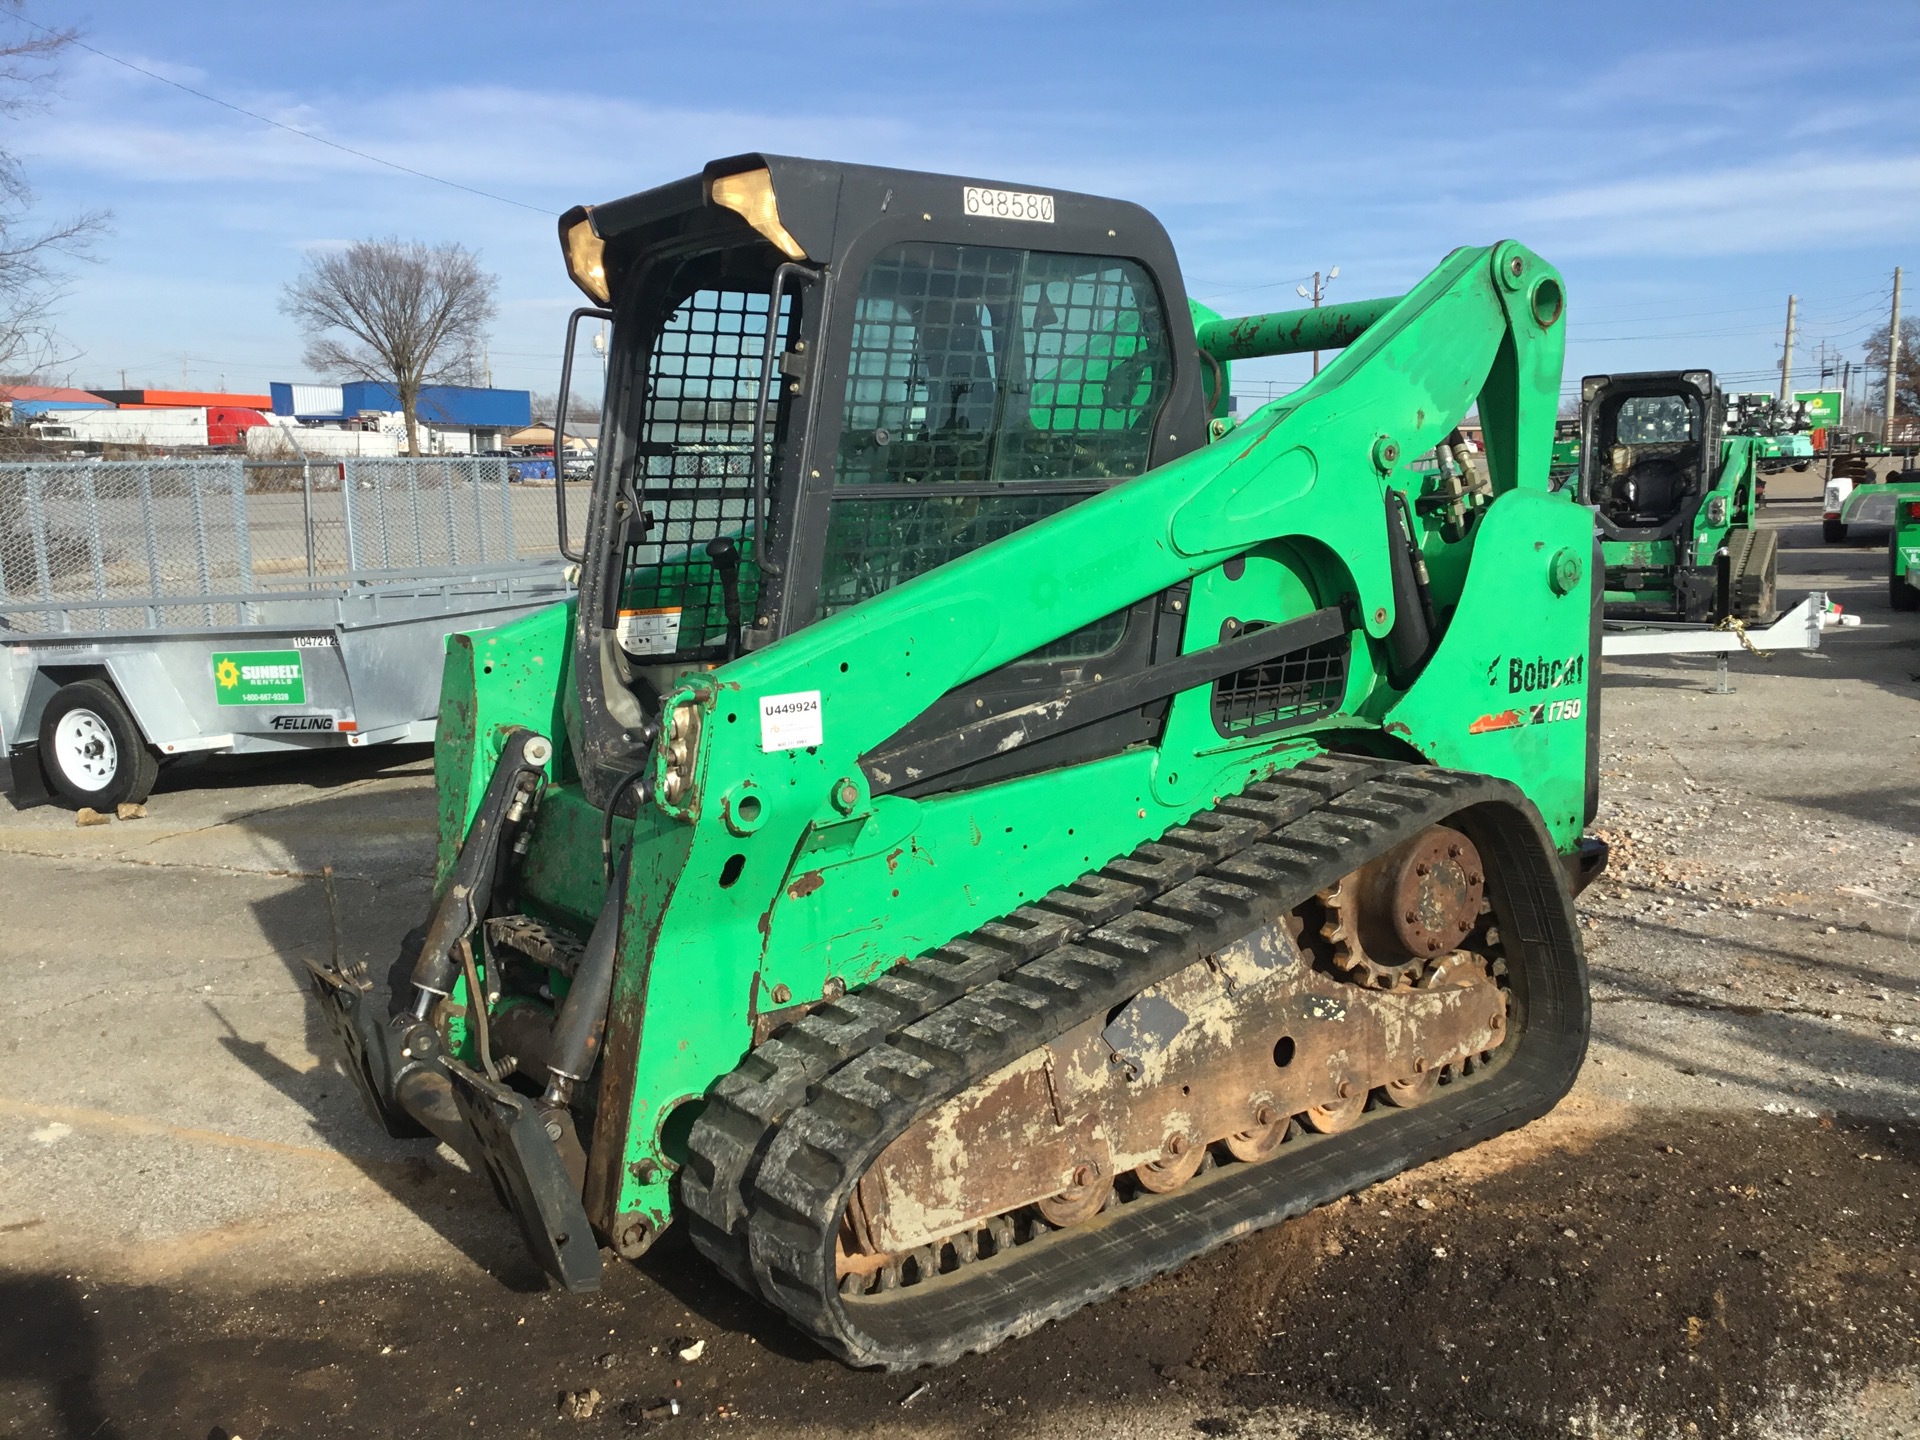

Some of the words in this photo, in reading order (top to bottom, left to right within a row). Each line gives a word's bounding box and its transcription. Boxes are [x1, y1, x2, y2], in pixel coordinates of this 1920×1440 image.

[967, 188, 1052, 221] 698580
[241, 665, 299, 680] SUNBELT
[1509, 653, 1584, 694] Bobcat
[765, 701, 817, 716] U449924
[270, 715, 334, 730] FELLING
